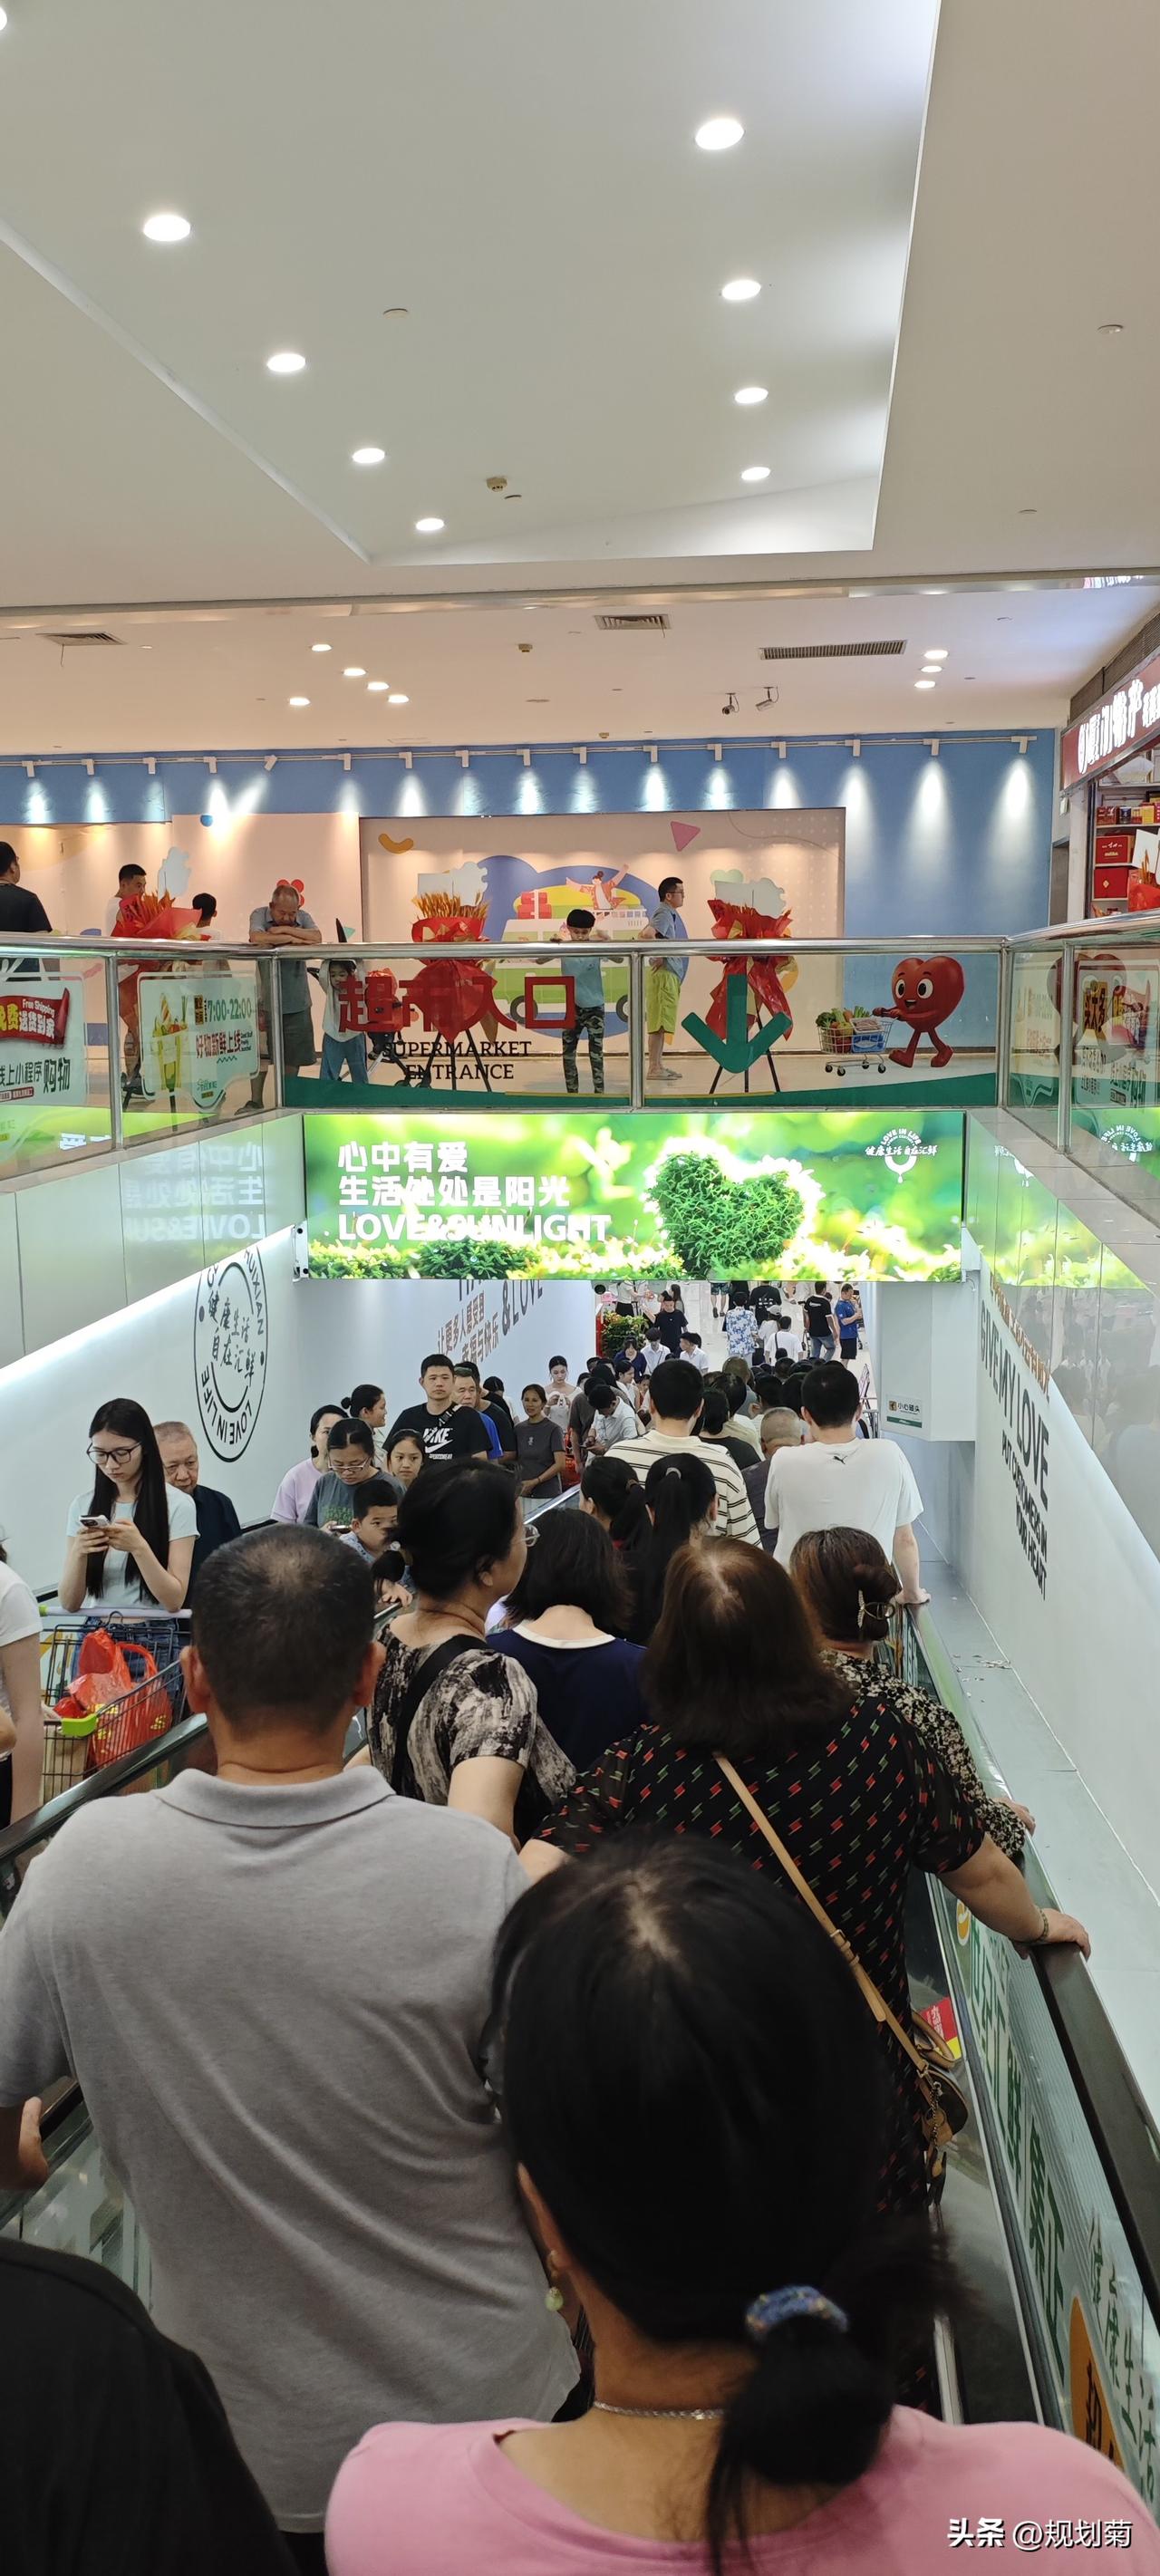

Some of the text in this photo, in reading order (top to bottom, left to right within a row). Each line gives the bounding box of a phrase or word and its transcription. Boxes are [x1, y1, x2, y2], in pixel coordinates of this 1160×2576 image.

[23, 999, 55, 1018] Free Shipping
[208, 998, 252, 1023] 7:00-22:00
[339, 975, 575, 1033] 超市入口
[386, 1041, 532, 1057] SUPERMARKET
[408, 1064, 515, 1080] ENTRANCE
[337, 1141, 469, 1173] 心中有爱
[880, 1129, 898, 1145] LOVE
[907, 1130, 922, 1145] LIFE
[339, 1175, 570, 1208] 生活处处是阳光
[338, 1213, 612, 1241] LOVE&SUNLIGHT
[208, 1289, 251, 1344] 健康生活
[212, 1327, 256, 1388] 自在汇鲜
[228, 1398, 253, 1445] LOVE
[981, 1299, 1050, 1512] GIVE MY LOVE
[1001, 1429, 1012, 1473] PUT
[1011, 1451, 1041, 1545] CUSTOMERS
[1015, 1496, 1048, 1601] YOUR HEART
[1089, 2205, 1157, 2504] 健康生活
